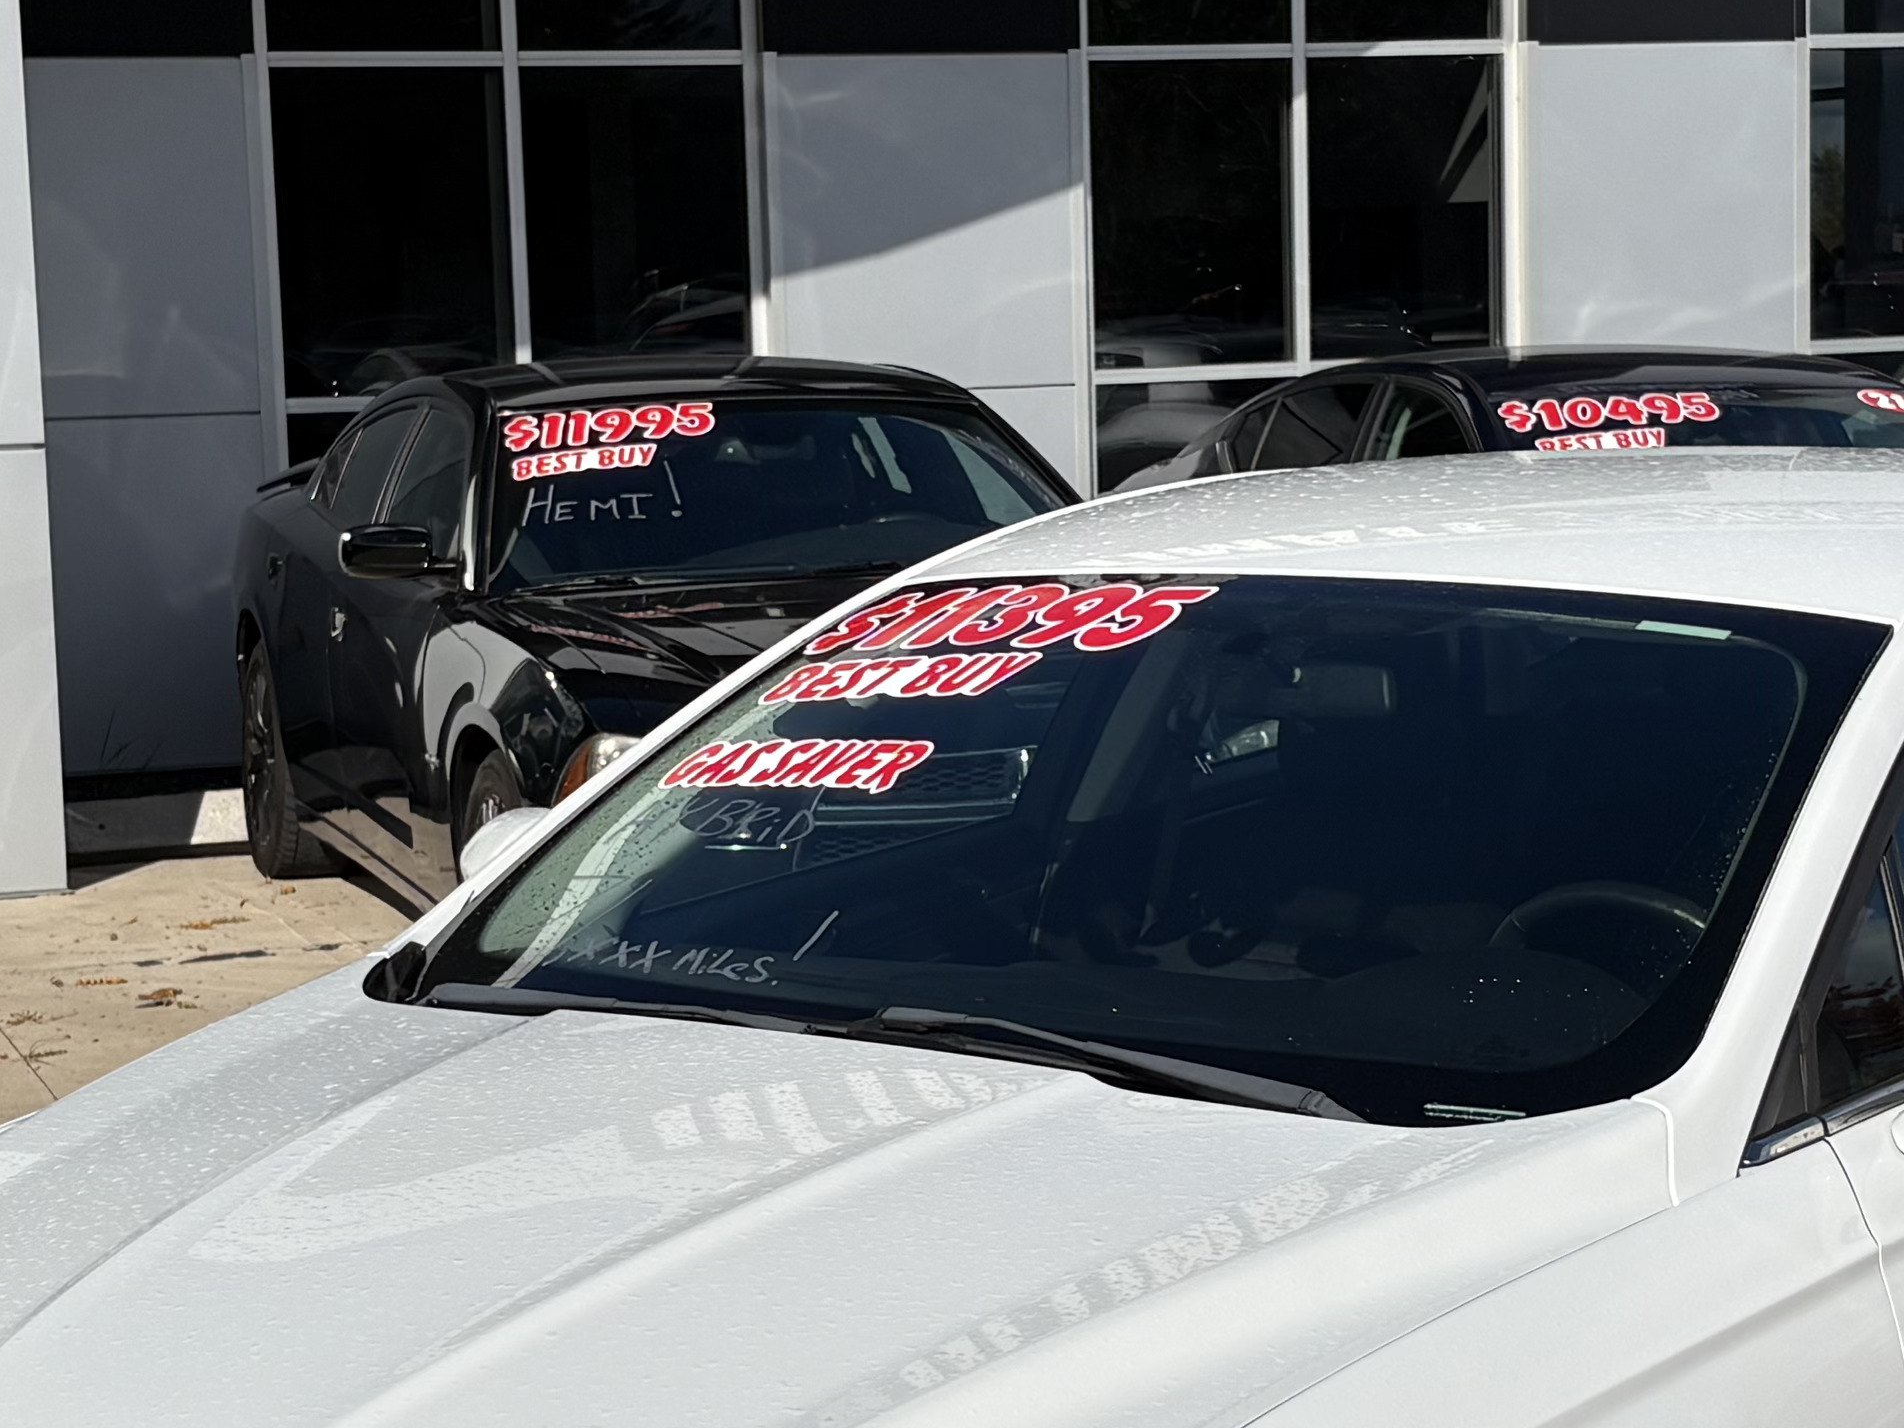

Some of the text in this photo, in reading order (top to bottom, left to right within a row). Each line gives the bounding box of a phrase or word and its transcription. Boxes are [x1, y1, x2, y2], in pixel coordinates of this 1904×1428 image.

[504, 402, 716, 451] $11995
[1497, 392, 1721, 433] $10495
[513, 443, 657, 479] BEST BUY
[1615, 428, 1666, 448] BUY
[802, 583, 1220, 655] $11395
[760, 653, 1043, 706] BEST BUY
[659, 740, 934, 794] GAS SAVER
